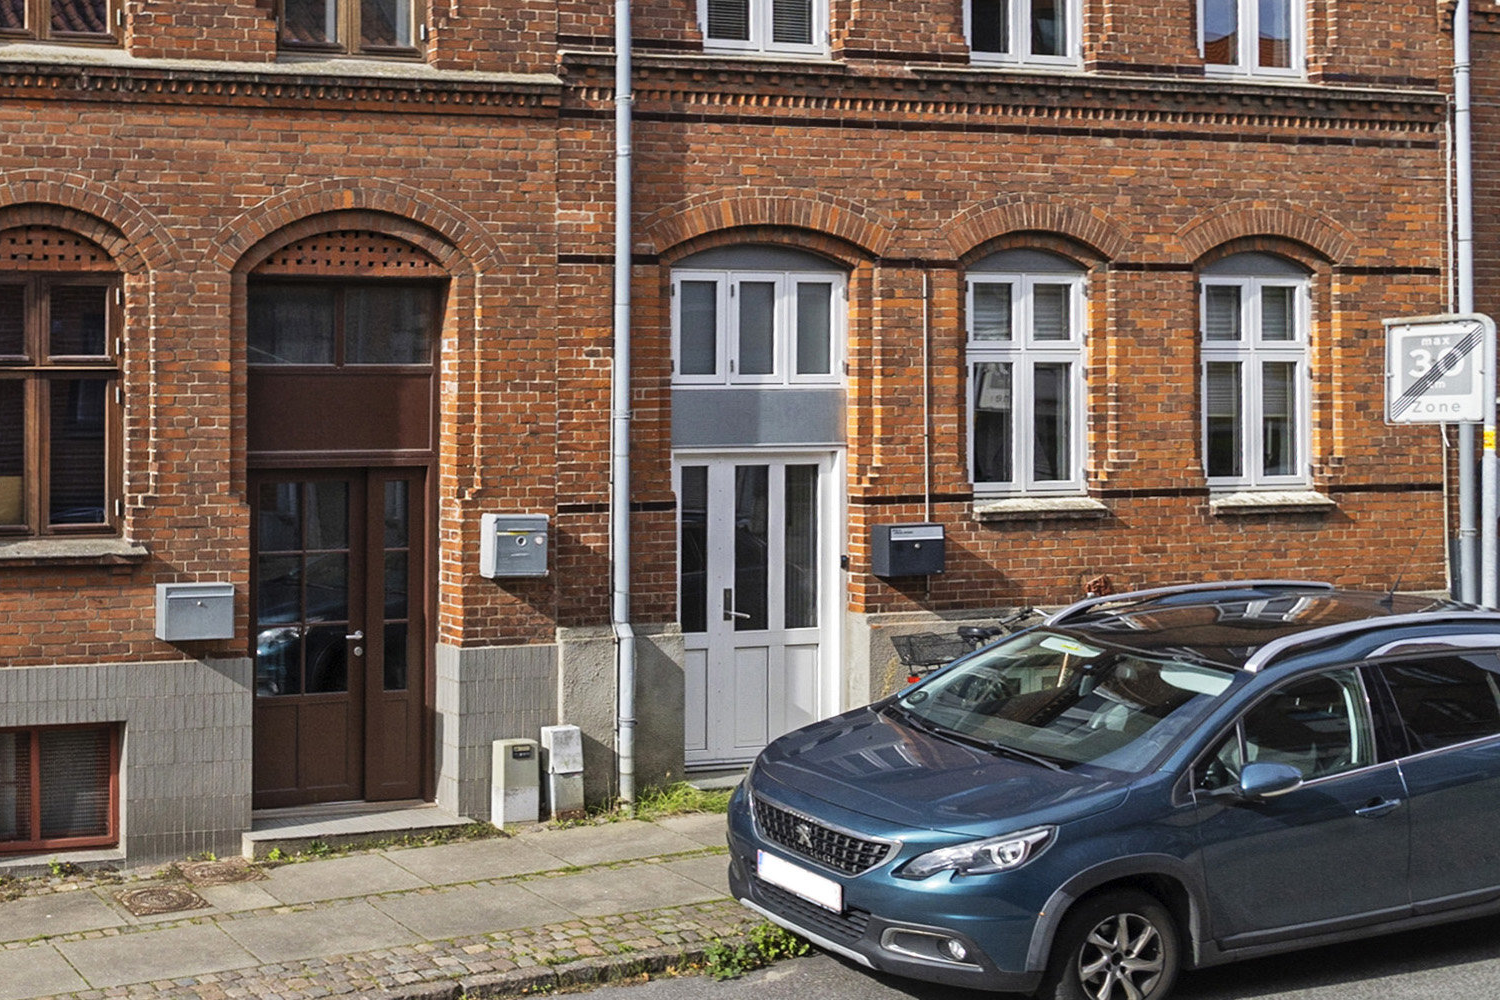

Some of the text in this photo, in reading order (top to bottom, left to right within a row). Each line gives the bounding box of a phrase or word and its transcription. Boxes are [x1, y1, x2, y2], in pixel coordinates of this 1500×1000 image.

[1421, 337, 1450, 345] max
[1408, 348, 1465, 377] 30
[1412, 400, 1461, 413] Zone
